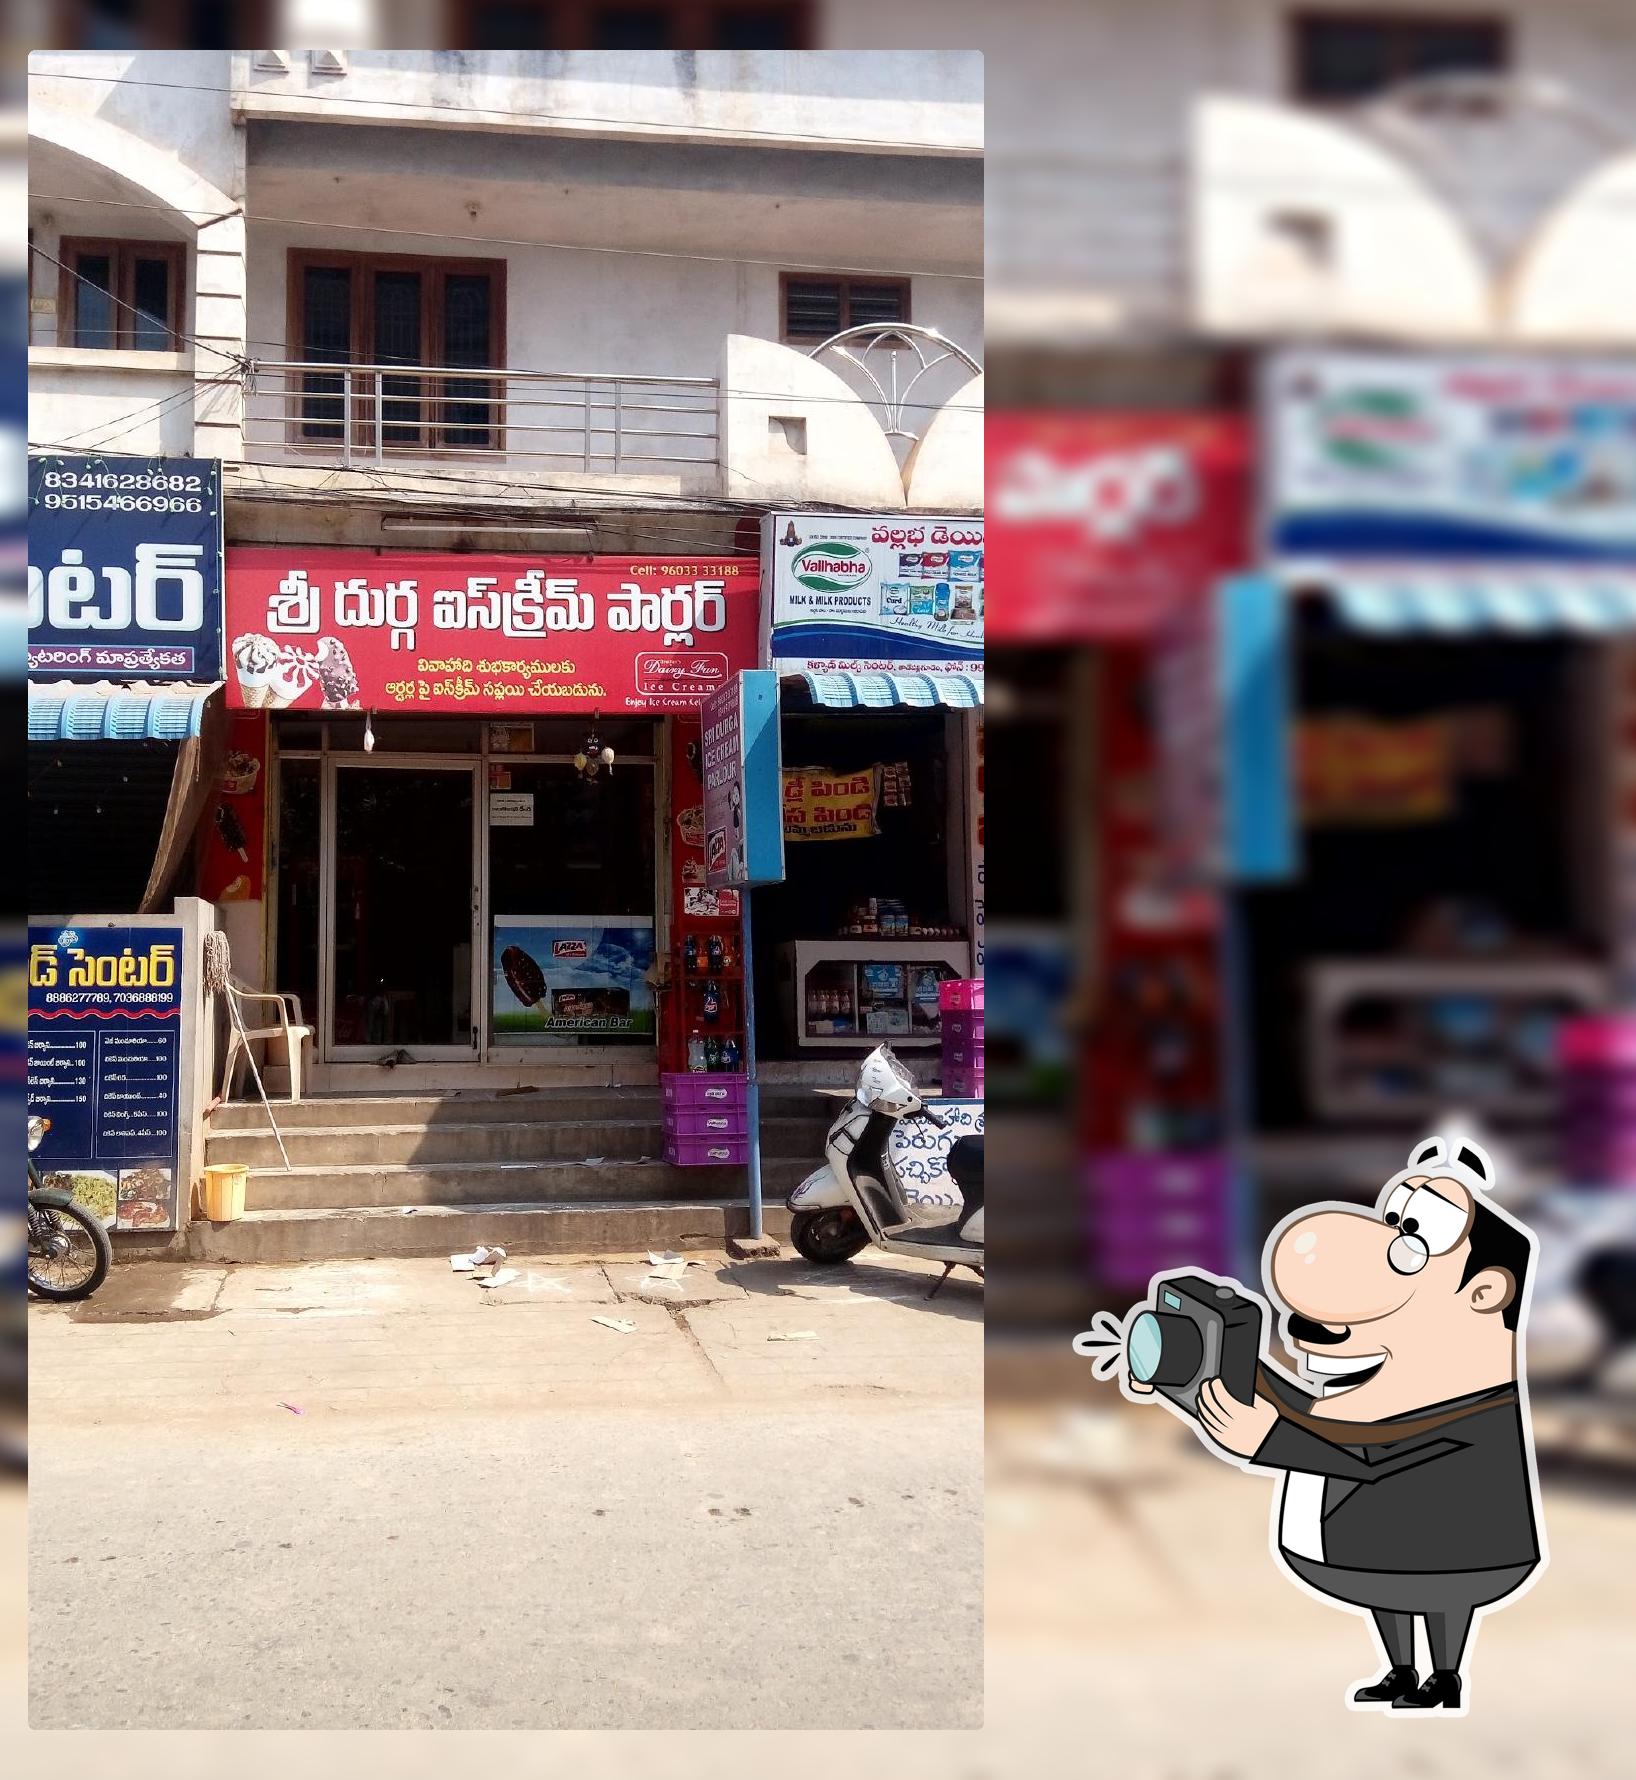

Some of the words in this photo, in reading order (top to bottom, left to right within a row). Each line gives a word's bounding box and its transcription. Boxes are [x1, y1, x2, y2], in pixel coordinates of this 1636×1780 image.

[45, 472, 202, 492] 8341628682
[45, 494, 202, 513] 9515466966
[872, 526, 925, 549] వల్లభ
[931, 526, 984, 546] డెయి
[629, 565, 657, 576] Cell:
[661, 565, 698, 576] 96033
[702, 565, 740, 576] 33188
[801, 559, 866, 573] Vallhabha
[266, 569, 322, 634] శ్రీ
[335, 579, 419, 650] దుర్గ
[607, 580, 726, 647] పార్లర్
[789, 595, 806, 605] MILK
[808, 596, 814, 605] &
[815, 596, 833, 605] MILK
[834, 596, 872, 606] PRODUCTS
[644, 659, 685, 679] Dairy
[690, 660, 720, 674] Fun
[644, 682, 664, 691] Ice
[625, 697, 647, 708] Enjoy
[649, 697, 661, 706] Ice
[663, 697, 688, 707] Cream
[690, 697, 701, 706] Cel
[716, 712, 738, 739] DURGA
[705, 750, 716, 769] ICE
[716, 734, 739, 763] CREAM
[707, 761, 737, 790] PARLOUR
[45, 993, 112, 1004] 8886277789,
[114, 993, 174, 1004] 7036888199
[545, 1016, 607, 1028] American
[609, 1016, 633, 1029] Bar
